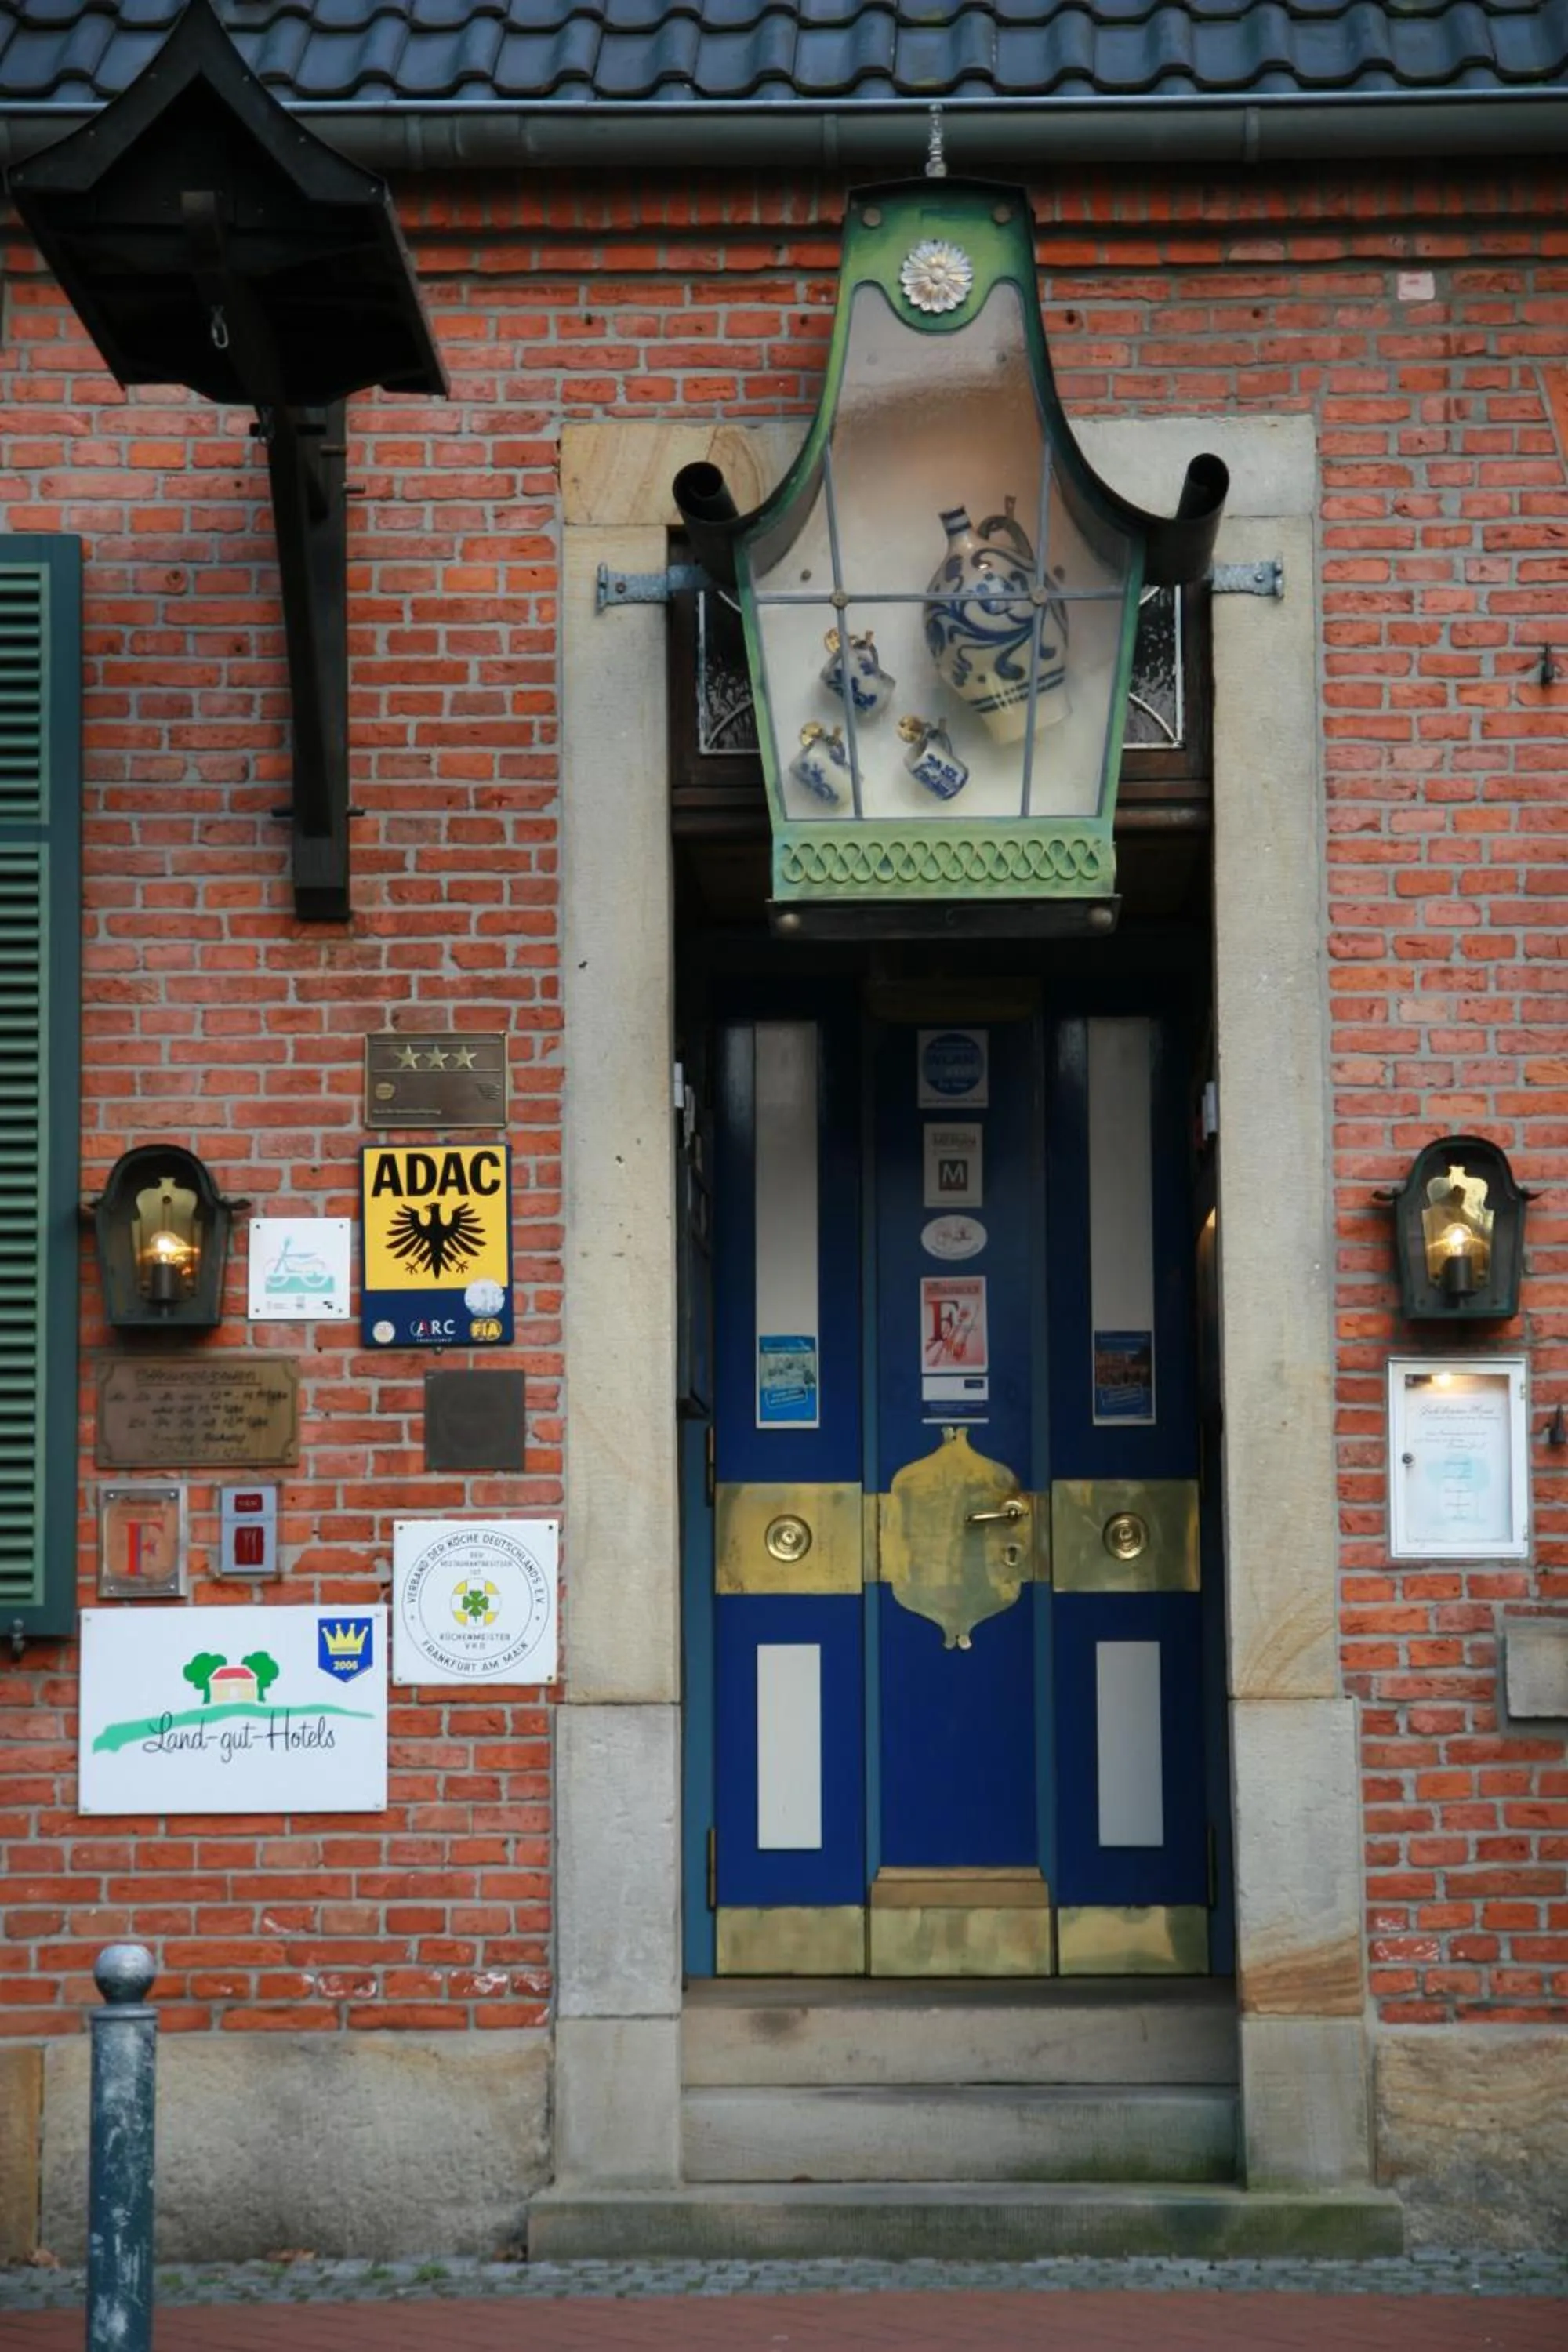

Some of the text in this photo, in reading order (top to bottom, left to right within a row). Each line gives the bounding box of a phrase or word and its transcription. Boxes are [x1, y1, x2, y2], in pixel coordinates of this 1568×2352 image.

[372, 1150, 501, 1197] ADAC
[414, 1319, 456, 1336] ARC
[472, 1322, 499, 1338] FIA
[407, 1559, 430, 1604] VERBAND
[427, 1544, 445, 1561] DER
[482, 1534, 543, 1584] DEUTSCHLANDS
[422, 1639, 477, 1671] FRANKFURT
[481, 1660, 499, 1671] AM
[142, 1708, 336, 1763] Land-gut-Hotels
